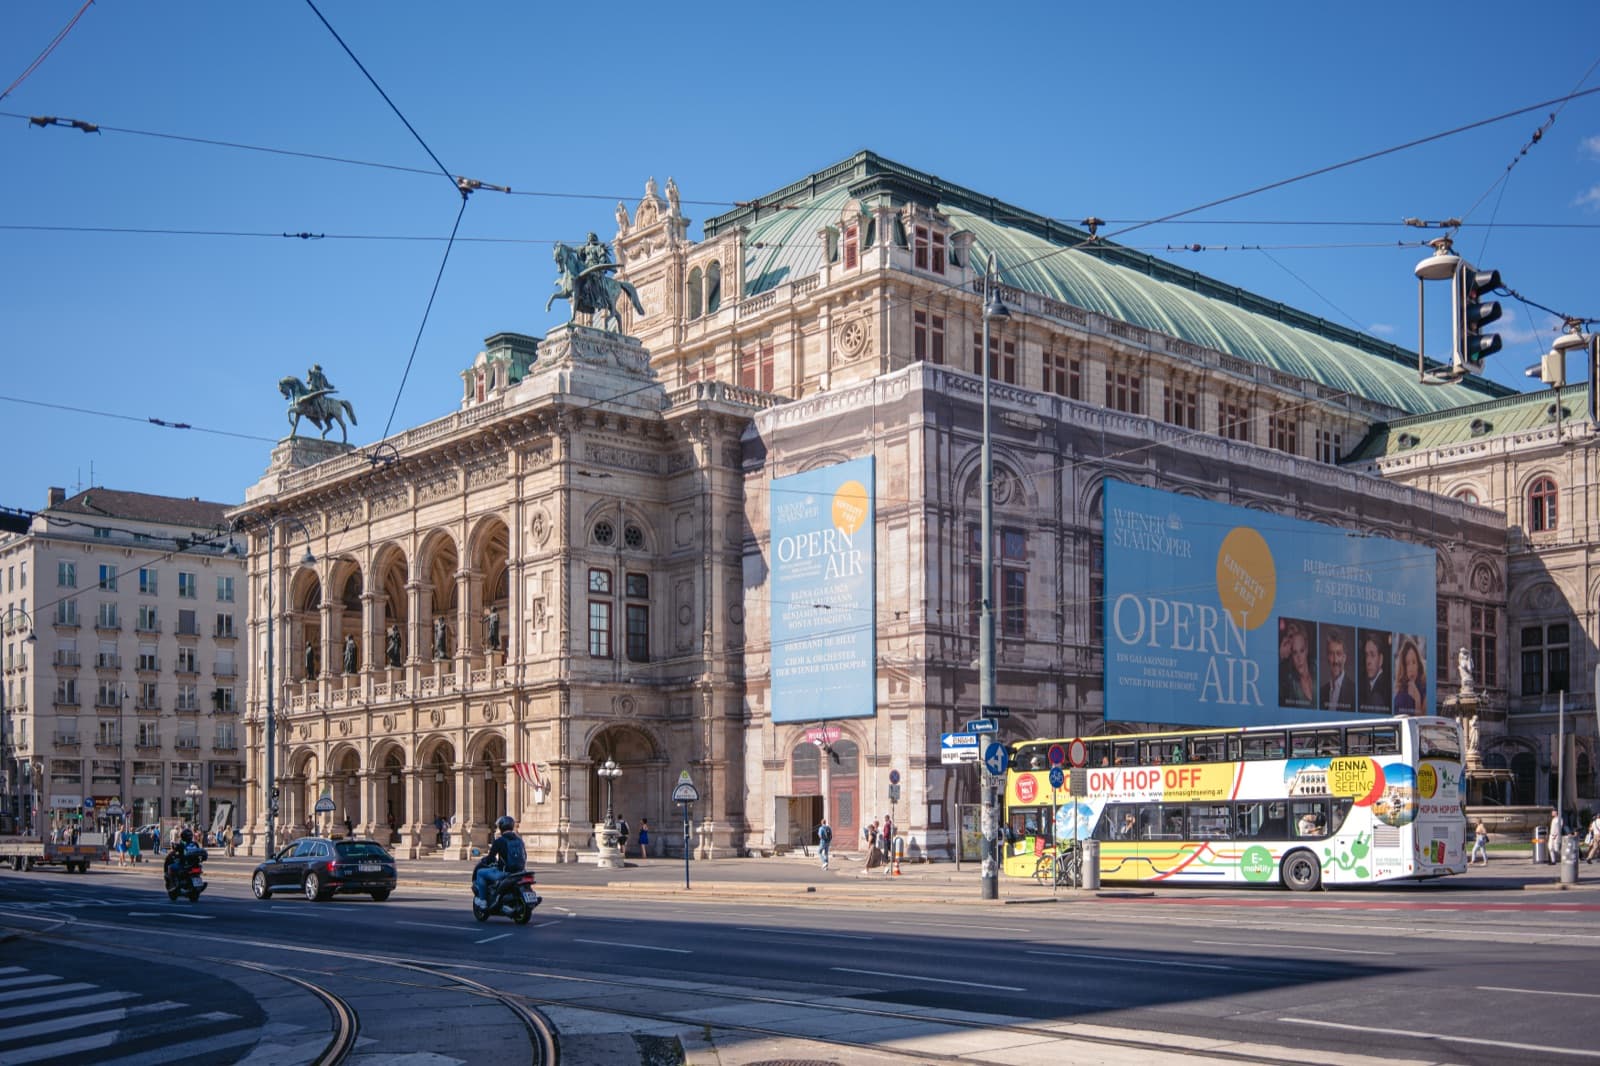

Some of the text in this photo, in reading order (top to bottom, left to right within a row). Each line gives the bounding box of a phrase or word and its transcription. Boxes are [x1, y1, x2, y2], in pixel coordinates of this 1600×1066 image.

[1113, 508, 1166, 535] WIENER
[778, 526, 855, 562] OPERN
[1113, 528, 1192, 558] STAATSOPER
[823, 550, 864, 581] AIR
[1223, 553, 1265, 600] EINTRITT
[1303, 559, 1373, 583] BURGGARTEN
[1233, 582, 1256, 608] FREI
[1326, 582, 1384, 602] SEPTEMBER
[1359, 604, 1380, 620] UHR
[1113, 593, 1248, 657] OPERN
[1198, 655, 1264, 706] AIR
[1329, 760, 1368, 771] VIENNA
[1335, 770, 1366, 782] SIGHT
[1090, 772, 1115, 791] ON
[1123, 769, 1160, 790] HOP
[1165, 768, 1202, 788] OFF
[1335, 781, 1375, 793] SEEING
[1251, 852, 1263, 864] E-
